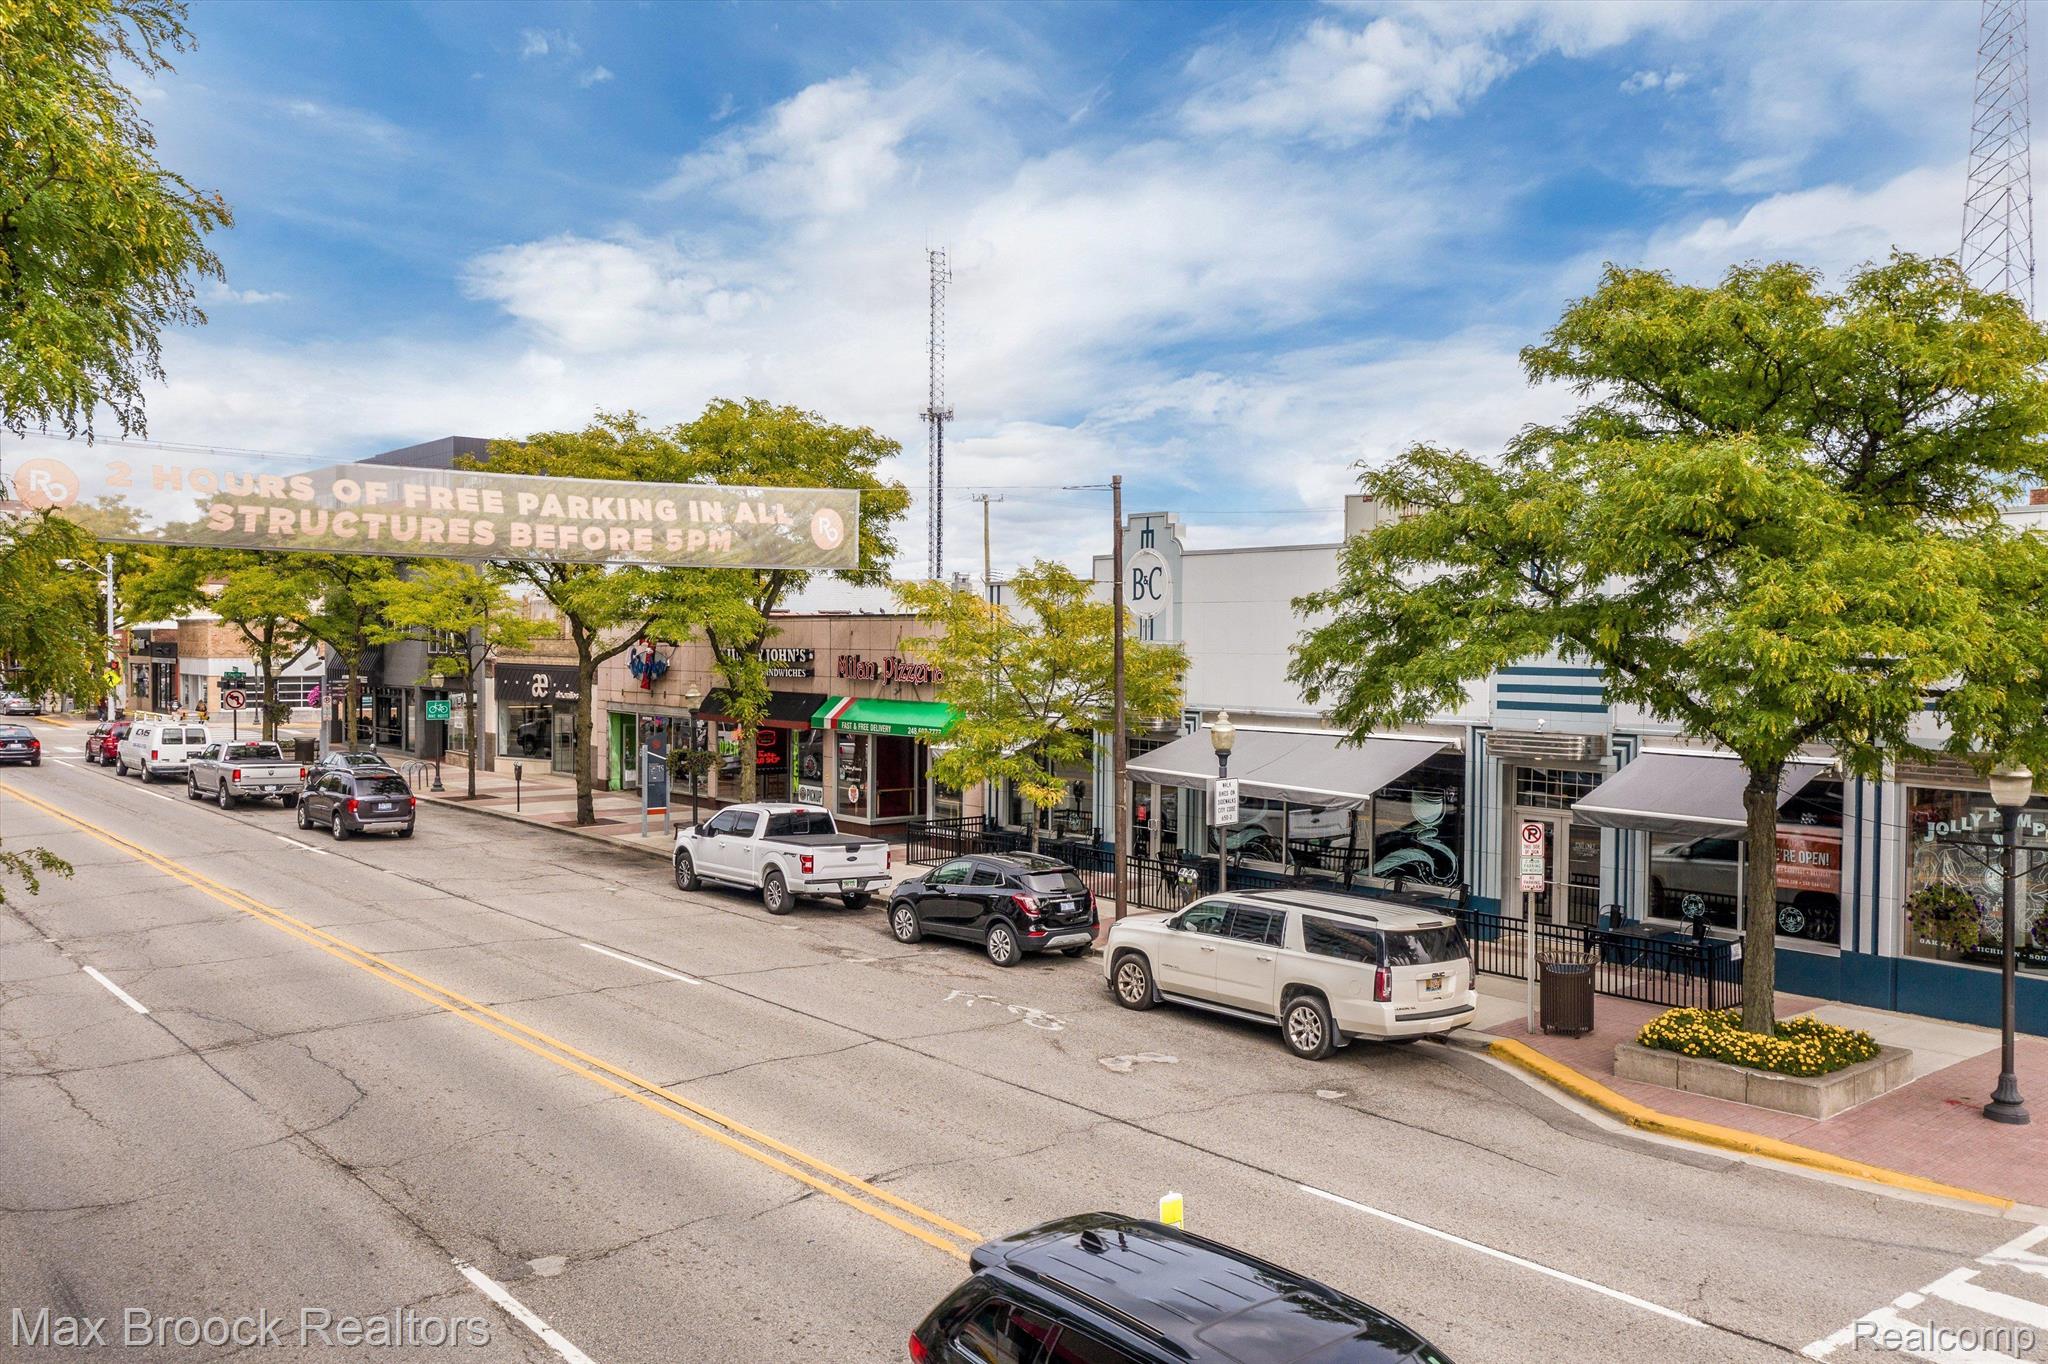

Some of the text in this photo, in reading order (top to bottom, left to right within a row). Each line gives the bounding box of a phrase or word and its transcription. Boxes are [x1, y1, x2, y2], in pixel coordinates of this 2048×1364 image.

[105, 461, 794, 526] 2 HOURS OF FREE PARKING IN ALL
[207, 503, 732, 553] STRUCTURES BEFORE 5PM
[766, 648, 806, 664] JOHN'S
[837, 655, 945, 685] Milan Pizzeria
[841, 721, 852, 730] FAST
[858, 723, 869, 731] FREE
[870, 724, 892, 733] DELIVERY
[807, 787, 822, 802] PICKUP
[1924, 808, 2048, 842] JOLLY PMP
[1798, 849, 1830, 866] OPEN!
[1919, 938, 1938, 946] OAK
